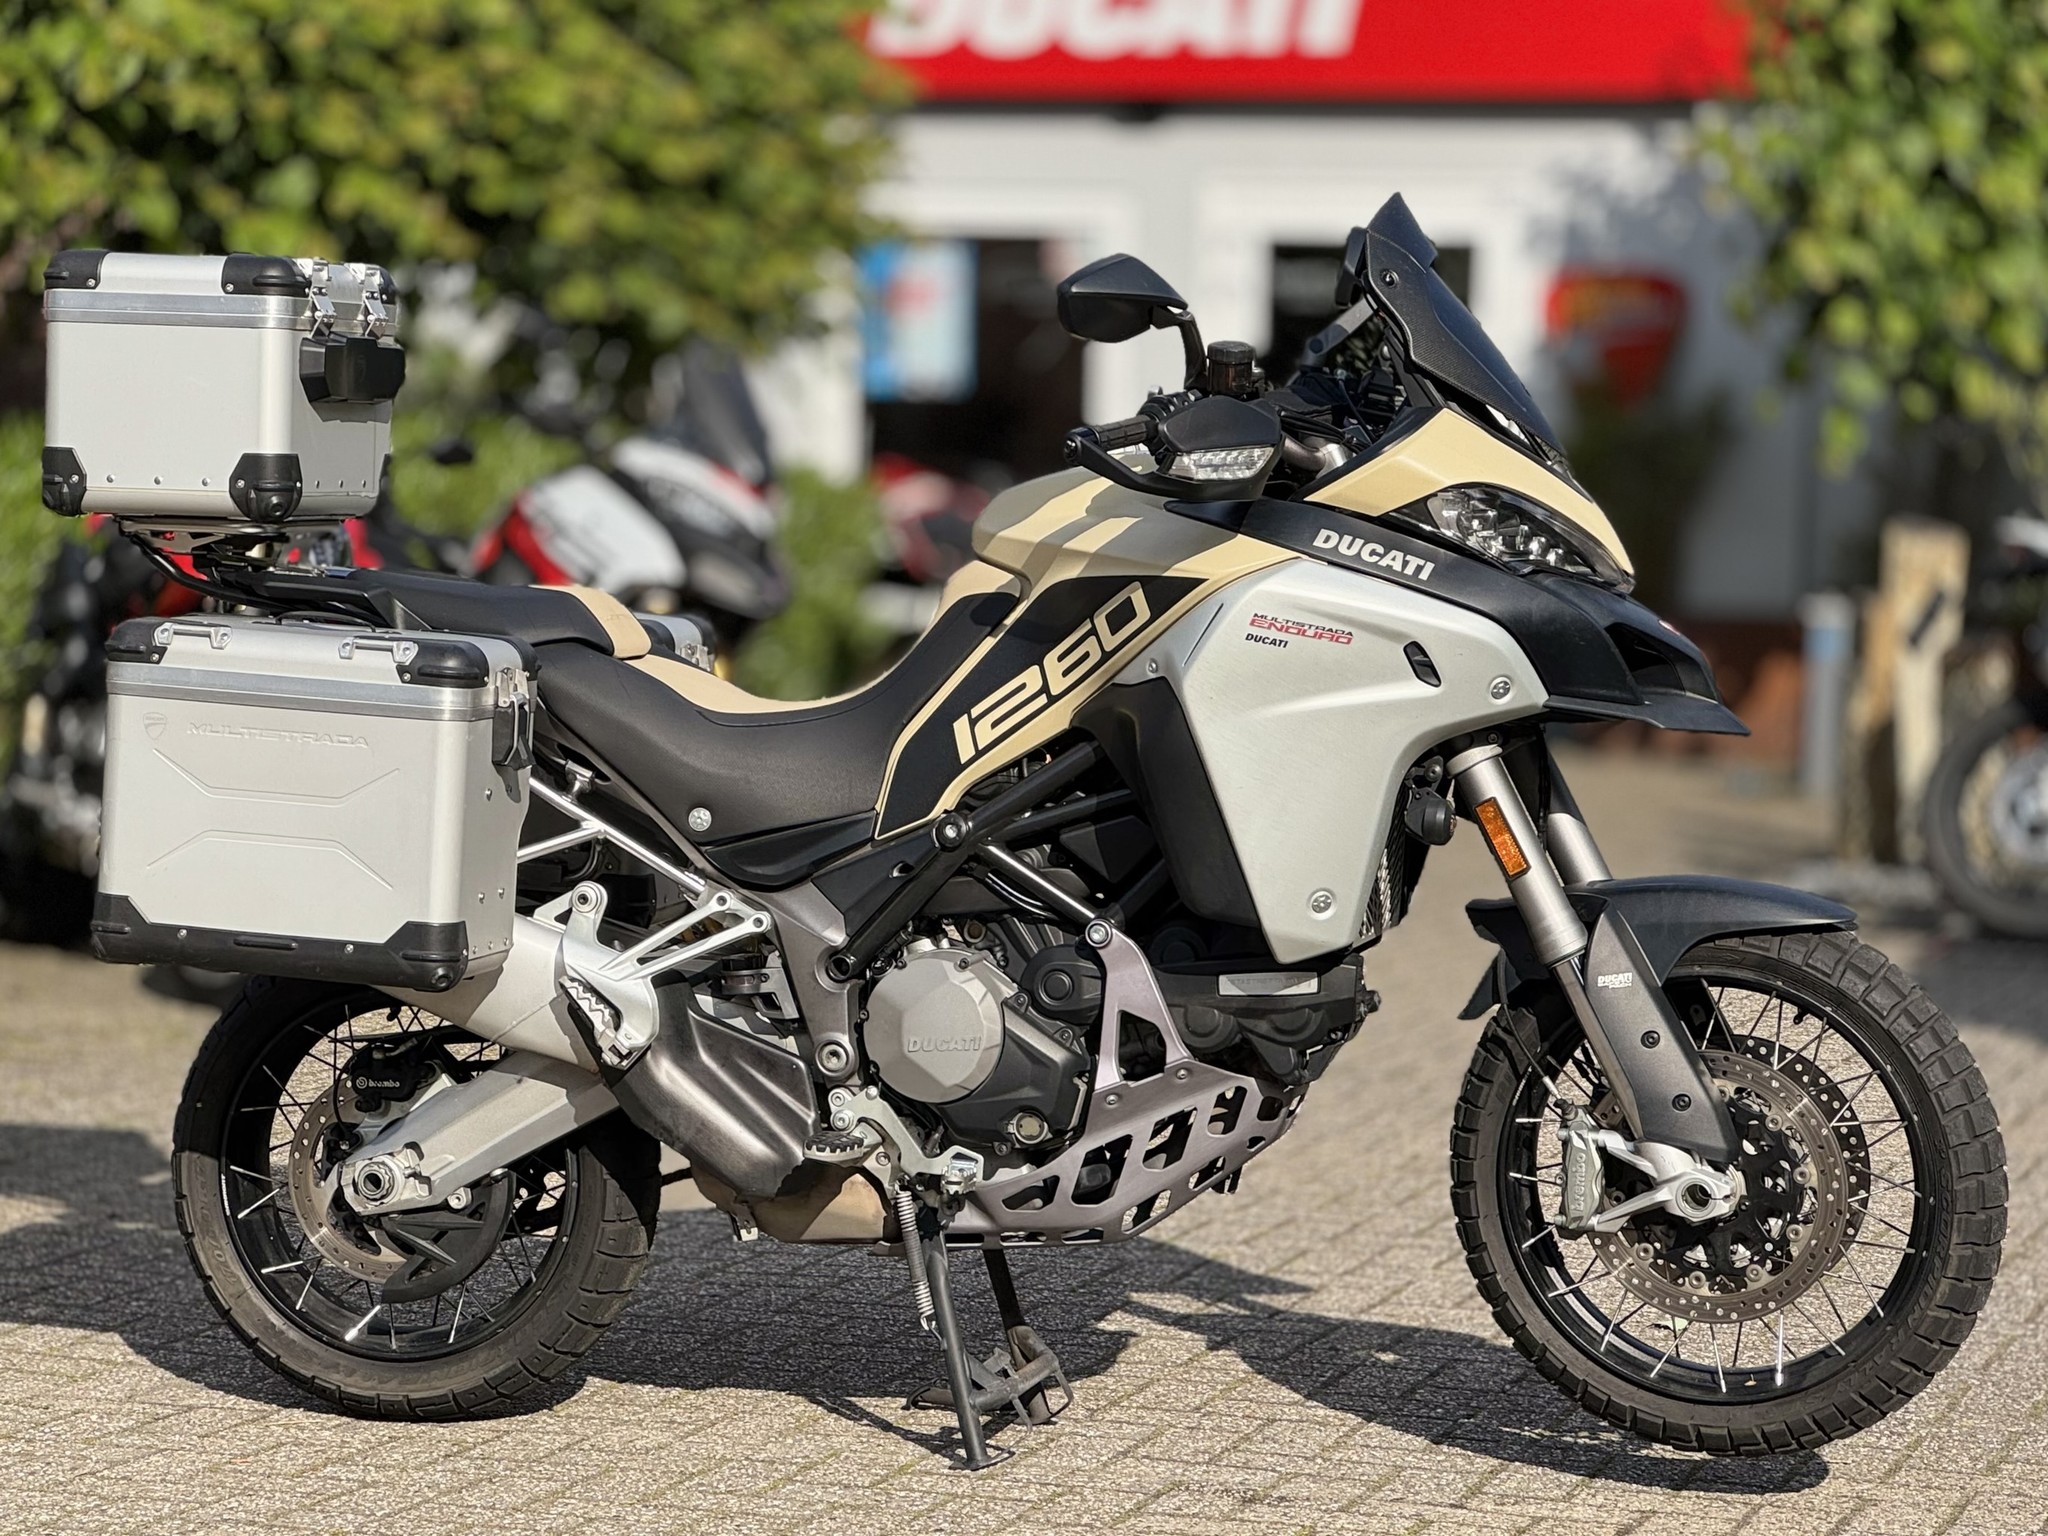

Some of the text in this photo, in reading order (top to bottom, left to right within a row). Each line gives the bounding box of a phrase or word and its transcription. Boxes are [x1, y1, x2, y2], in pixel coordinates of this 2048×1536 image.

[1313, 529, 1435, 580] DUCATI
[1249, 619, 1354, 645] ENDURO
[1253, 613, 1354, 636] MULTISTRADA
[1245, 633, 1289, 648] DUCATI
[953, 581, 1151, 764] 1260
[186, 722, 369, 748] MULTISTRADA
[1598, 972, 1632, 983] DUCATI
[908, 1037, 981, 1052] DUCATI
[1572, 1152, 1586, 1211] brembo
